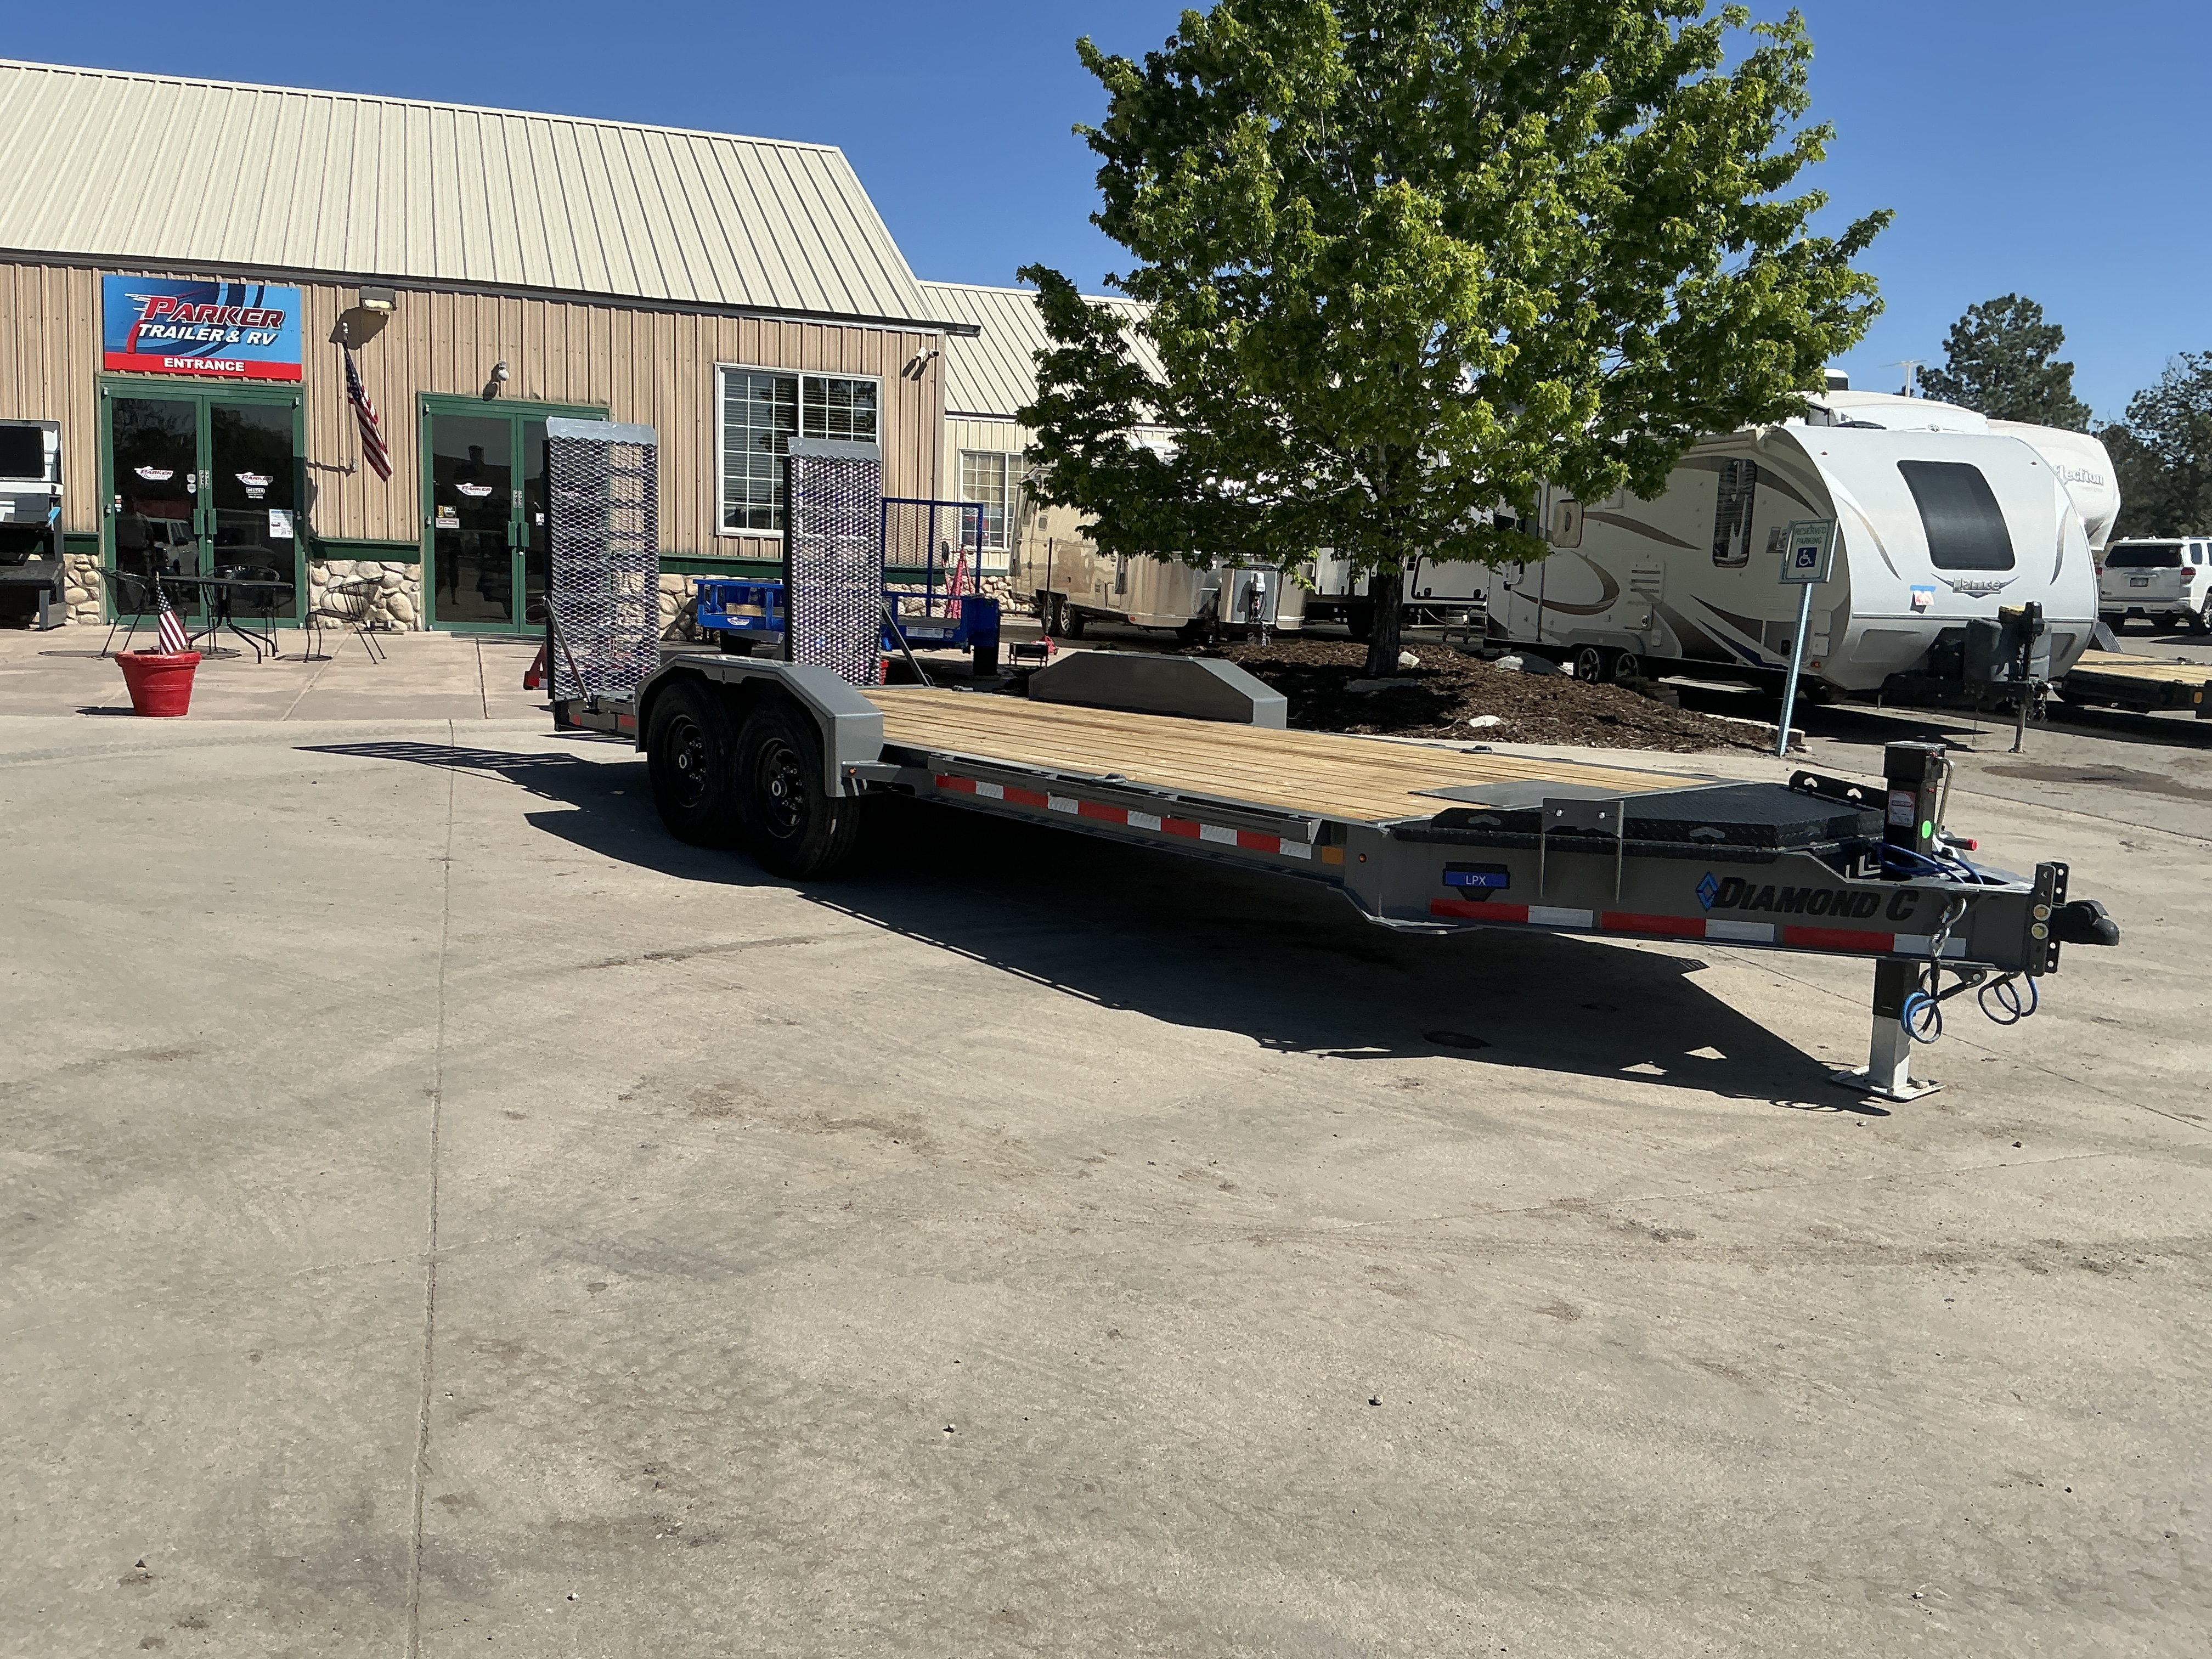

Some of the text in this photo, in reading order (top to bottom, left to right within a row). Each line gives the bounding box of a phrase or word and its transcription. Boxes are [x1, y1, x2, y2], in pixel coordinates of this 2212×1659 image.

[140, 296, 284, 329] PARKER
[138, 324, 276, 345] TRAILER & RV
[164, 357, 245, 371] ENTRANCE
[1795, 527, 1826, 535] RESERVED
[1465, 875, 1486, 885] LPX
[1886, 889, 1920, 921] C
